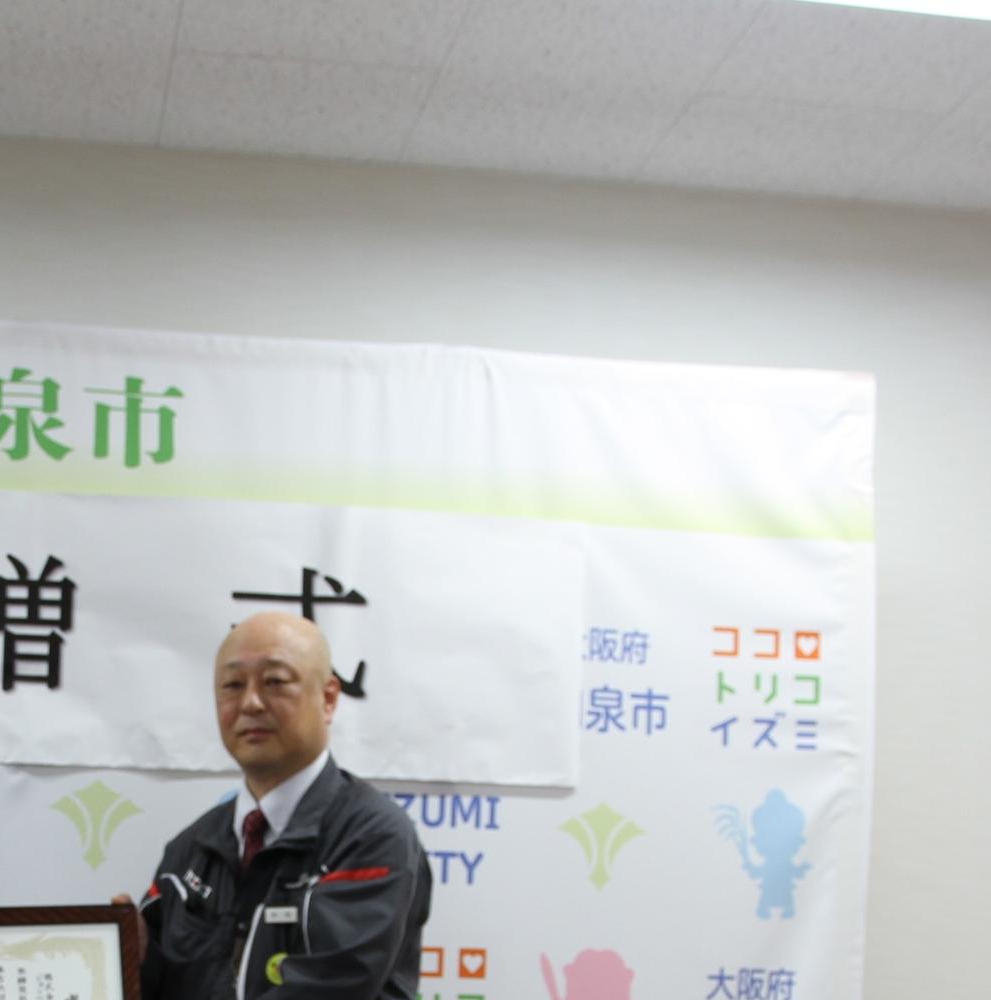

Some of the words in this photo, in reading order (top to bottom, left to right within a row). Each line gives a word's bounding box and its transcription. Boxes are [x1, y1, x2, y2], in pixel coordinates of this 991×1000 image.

[583, 628, 648, 664] 阪府
[717, 672, 821, 705] トリコ
[580, 685, 670, 735] 泉市
[711, 713, 818, 750] イズミ
